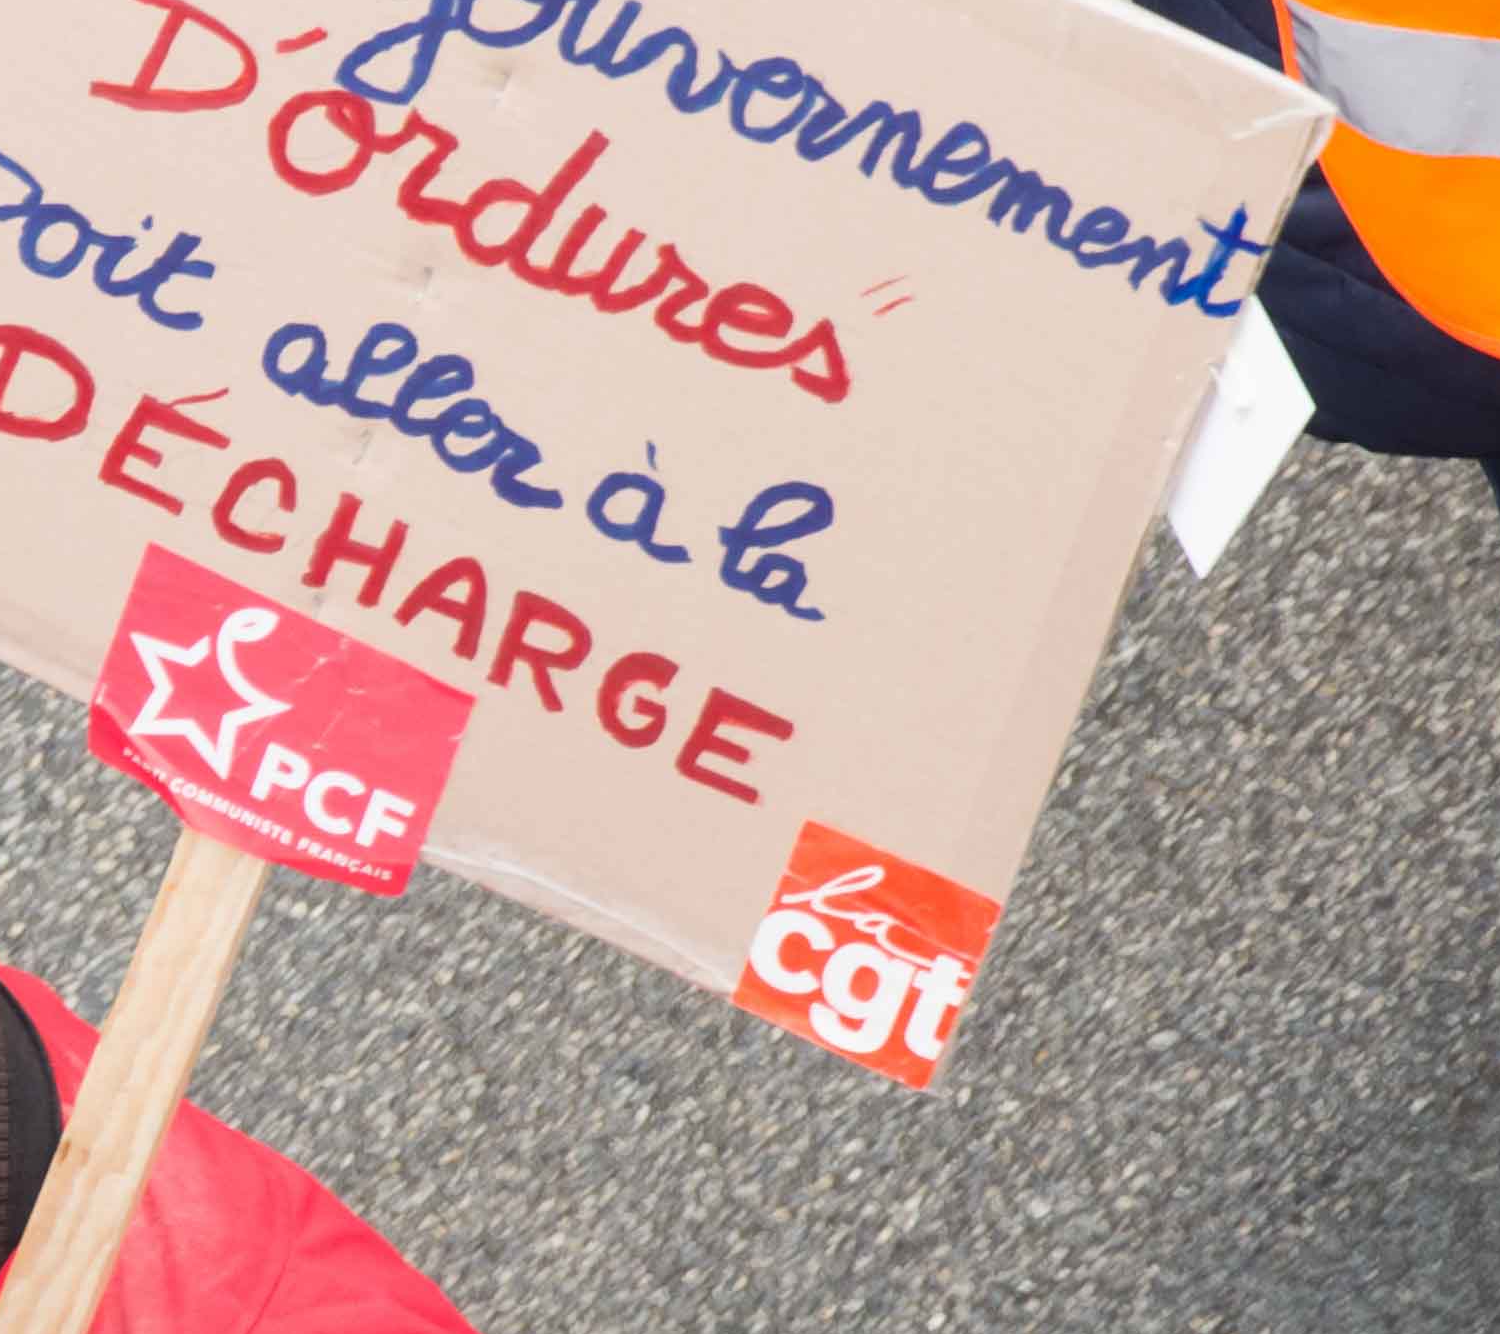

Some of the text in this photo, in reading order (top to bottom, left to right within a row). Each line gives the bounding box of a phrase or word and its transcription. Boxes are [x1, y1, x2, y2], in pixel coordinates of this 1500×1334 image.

[261, 322, 563, 510] aller
[586, 442, 693, 564] à
[718, 480, 827, 622] la
[168, 777, 294, 846] COMMUNISTE
[249, 741, 417, 848] PCF
[780, 864, 936, 969] la
[749, 908, 973, 1062] cgt
